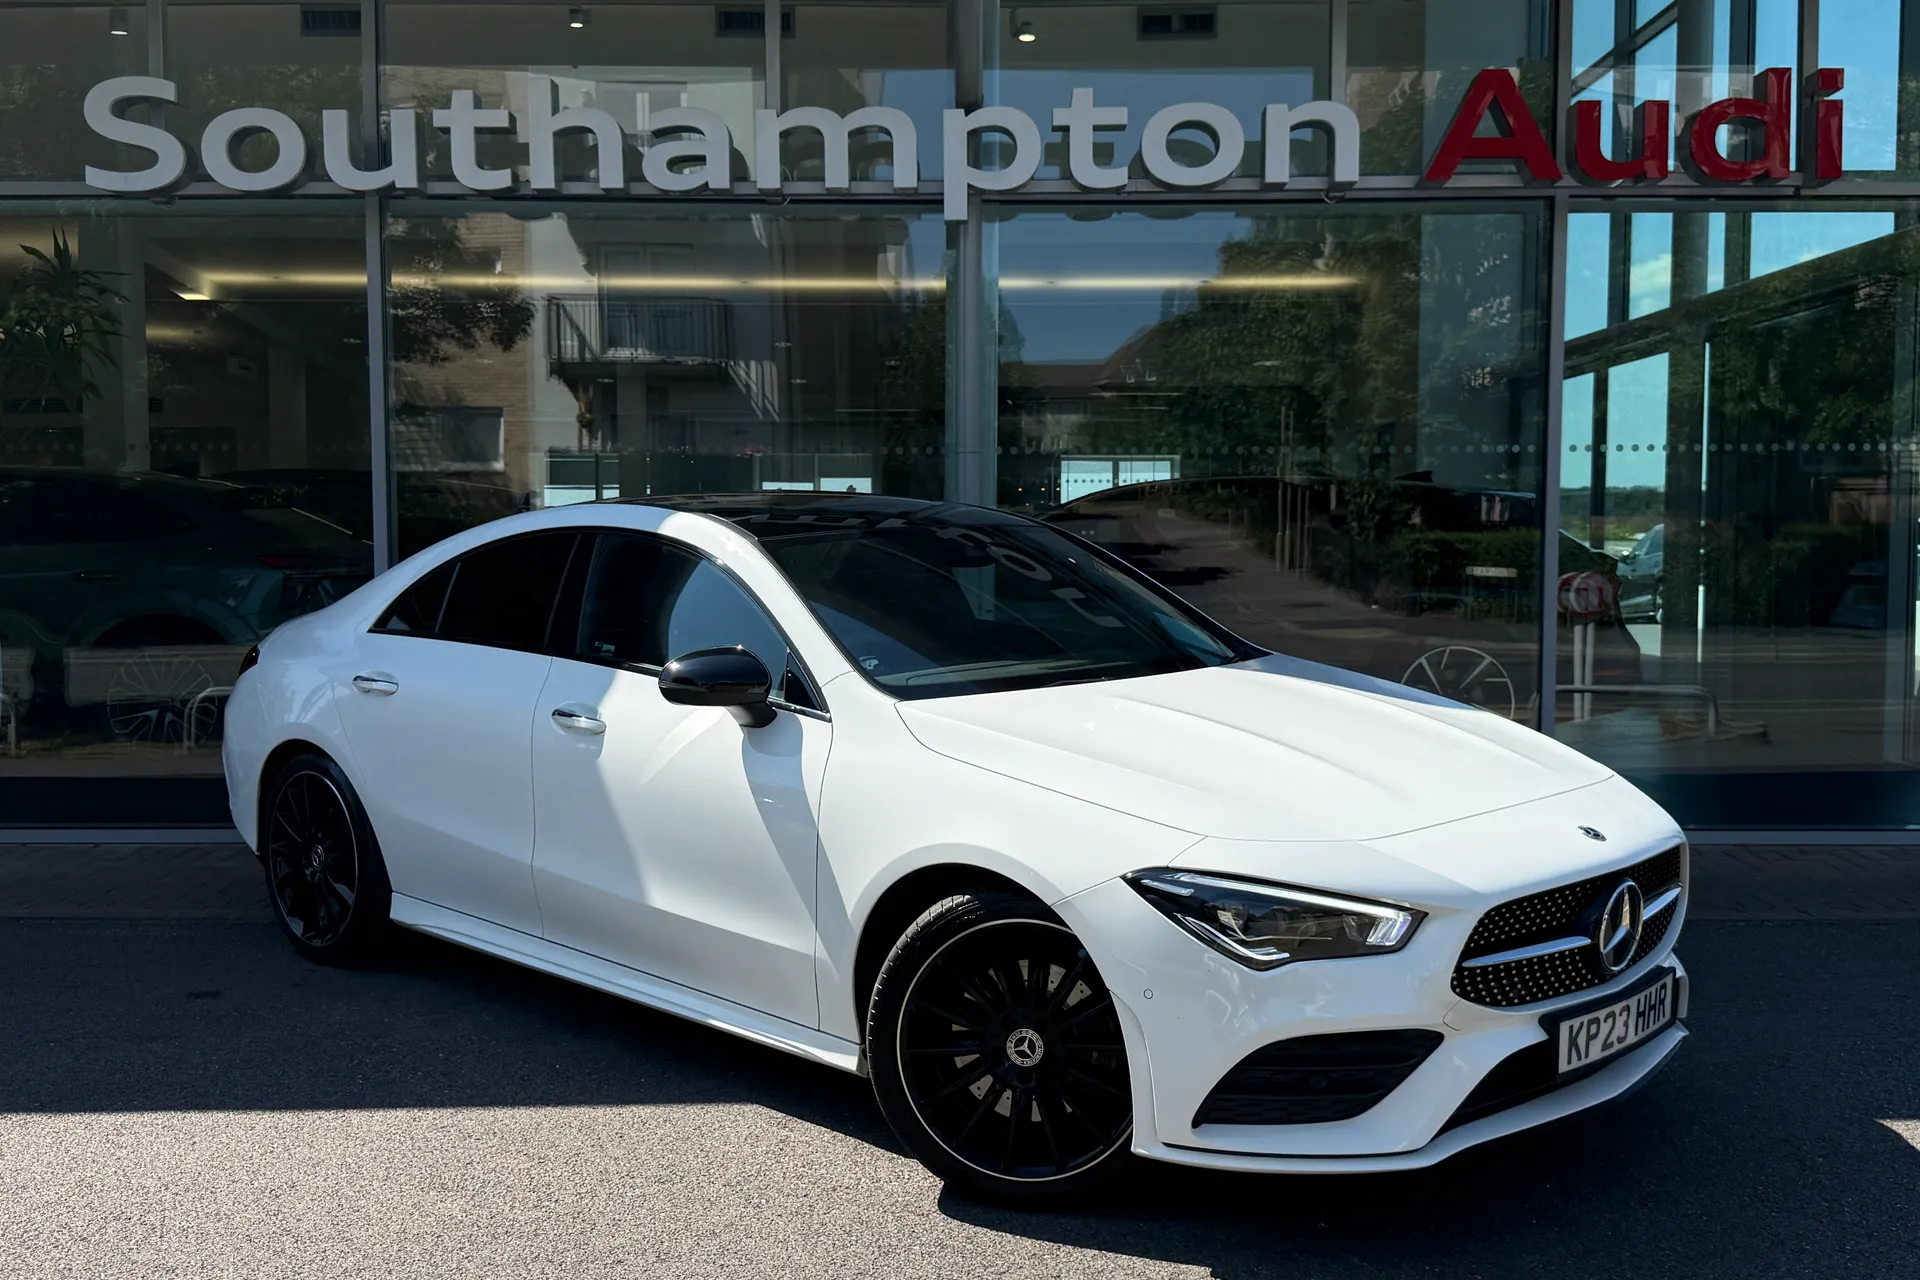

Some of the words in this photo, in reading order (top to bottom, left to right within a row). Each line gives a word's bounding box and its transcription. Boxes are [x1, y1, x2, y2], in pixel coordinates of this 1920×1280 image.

[84, 76, 1360, 220] Southampton
[1425, 68, 1844, 182] Audi
[1567, 1004, 1631, 1065] KP23
[1635, 981, 1667, 1037] HHR
